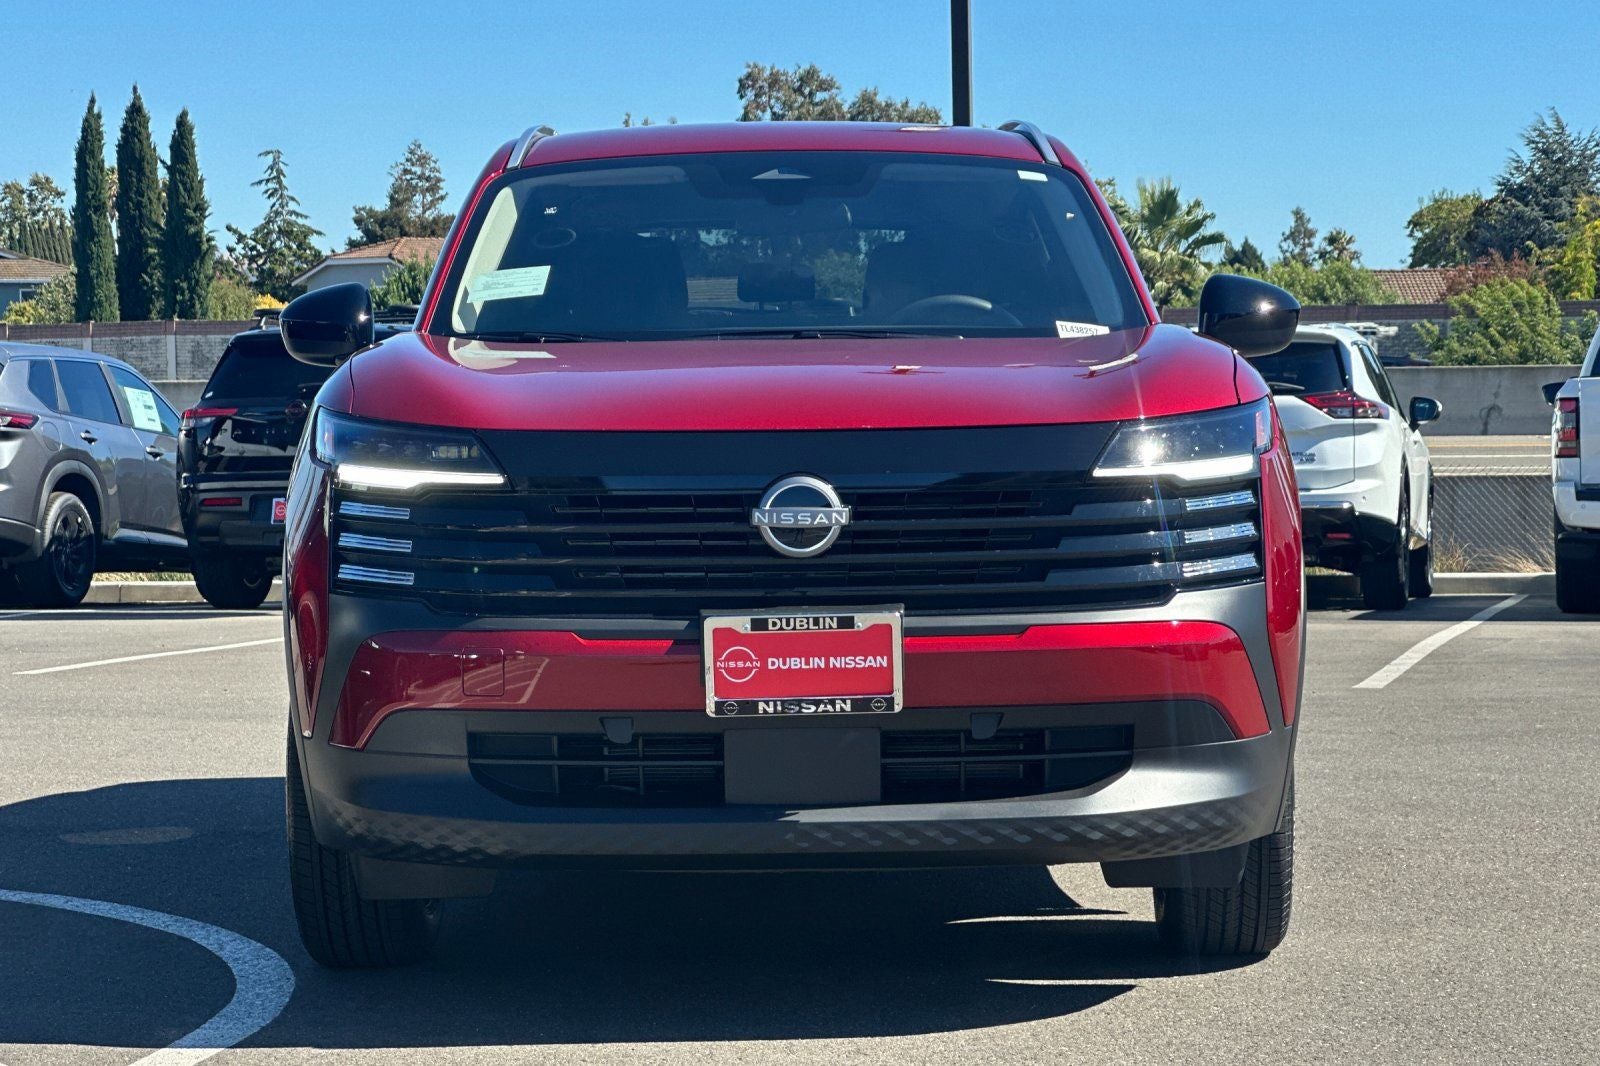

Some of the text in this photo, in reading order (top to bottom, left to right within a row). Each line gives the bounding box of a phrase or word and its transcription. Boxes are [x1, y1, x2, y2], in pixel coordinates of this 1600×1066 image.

[754, 511, 846, 525] NISSAN
[767, 616, 838, 631] DUBLIN
[716, 660, 761, 668] NISSAN
[767, 655, 888, 670] DUBLIN NISSAN
[758, 699, 852, 714] NISSAN
